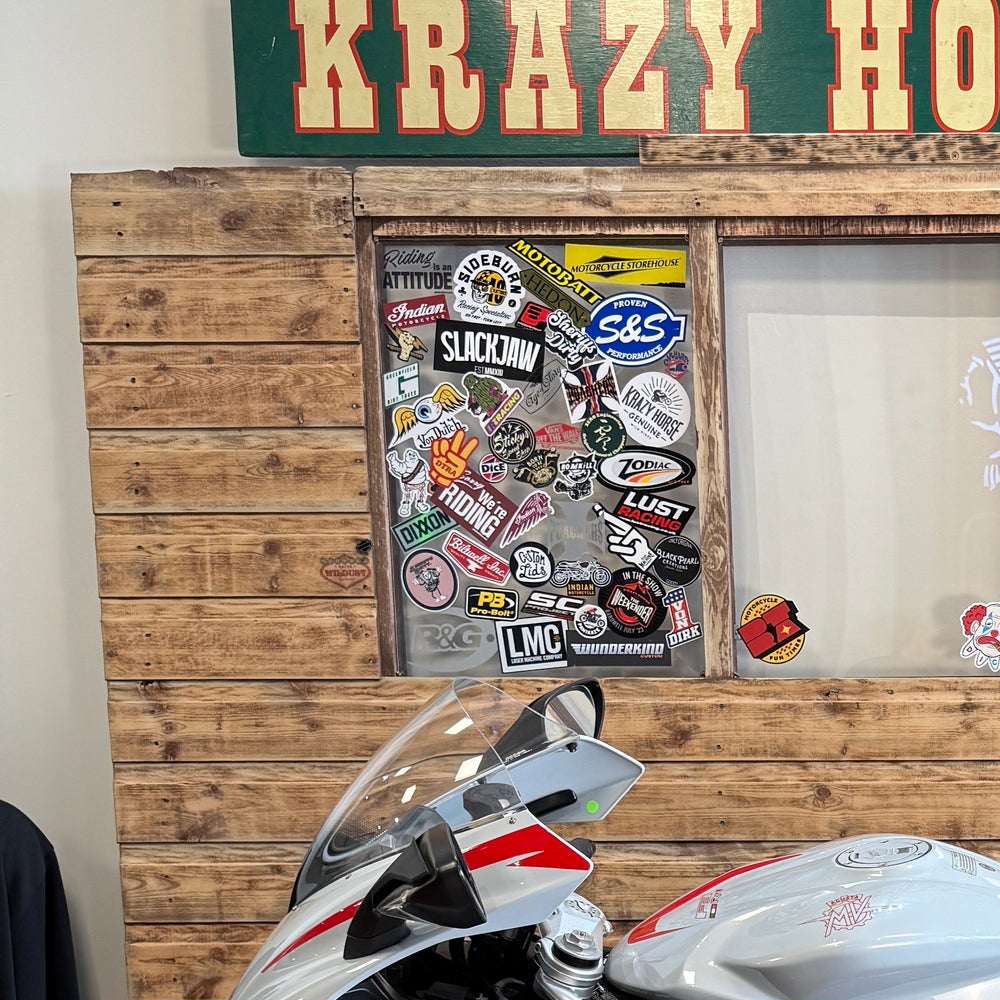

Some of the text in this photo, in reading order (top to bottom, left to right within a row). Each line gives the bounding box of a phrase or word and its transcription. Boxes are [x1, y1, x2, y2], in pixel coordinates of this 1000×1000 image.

[291, 0, 761, 135] KRAZY
[383, 248, 436, 269] Riding
[433, 263, 441, 271] is
[511, 238, 600, 304] MOTOBATT
[570, 258, 680, 273] MOTORCYCLE STOREHOUSE
[382, 271, 453, 290] ATTITUDE
[457, 253, 522, 295] SIDEBURN
[527, 273, 586, 324] HEDON
[612, 299, 648, 310] PROVEN
[387, 302, 446, 323] Indian
[594, 313, 668, 344] S&S
[440, 330, 542, 373] SLACKJAW
[606, 344, 663, 361] PERFORMANCE
[622, 385, 652, 417] KRAZY
[651, 406, 685, 442] HORSE
[628, 412, 661, 439] GENUINE
[434, 459, 458, 477] DTRA
[618, 458, 672, 480] ZODIAC
[438, 483, 501, 539] RIDING
[617, 505, 682, 532] RACING
[622, 491, 690, 520] LUST
[399, 509, 452, 545] DIXXON
[448, 537, 489, 566] Biltwell
[518, 564, 547, 579] Lids
[622, 572, 631, 581] IN
[632, 571, 645, 581] THE
[645, 577, 664, 598] SHOW
[477, 590, 506, 609] PB
[568, 583, 595, 591] INDIAN
[470, 607, 513, 618] Pro-Bolt
[610, 587, 654, 625] WEEKENDER
[670, 600, 690, 631] VON
[743, 597, 778, 621] MOTORCYCLE
[413, 624, 483, 652] R&G
[506, 624, 562, 660] LMC
[570, 643, 665, 656] WUNDERKIND
[668, 625, 702, 647] DIRK
[785, 639, 802, 657] TIMES
